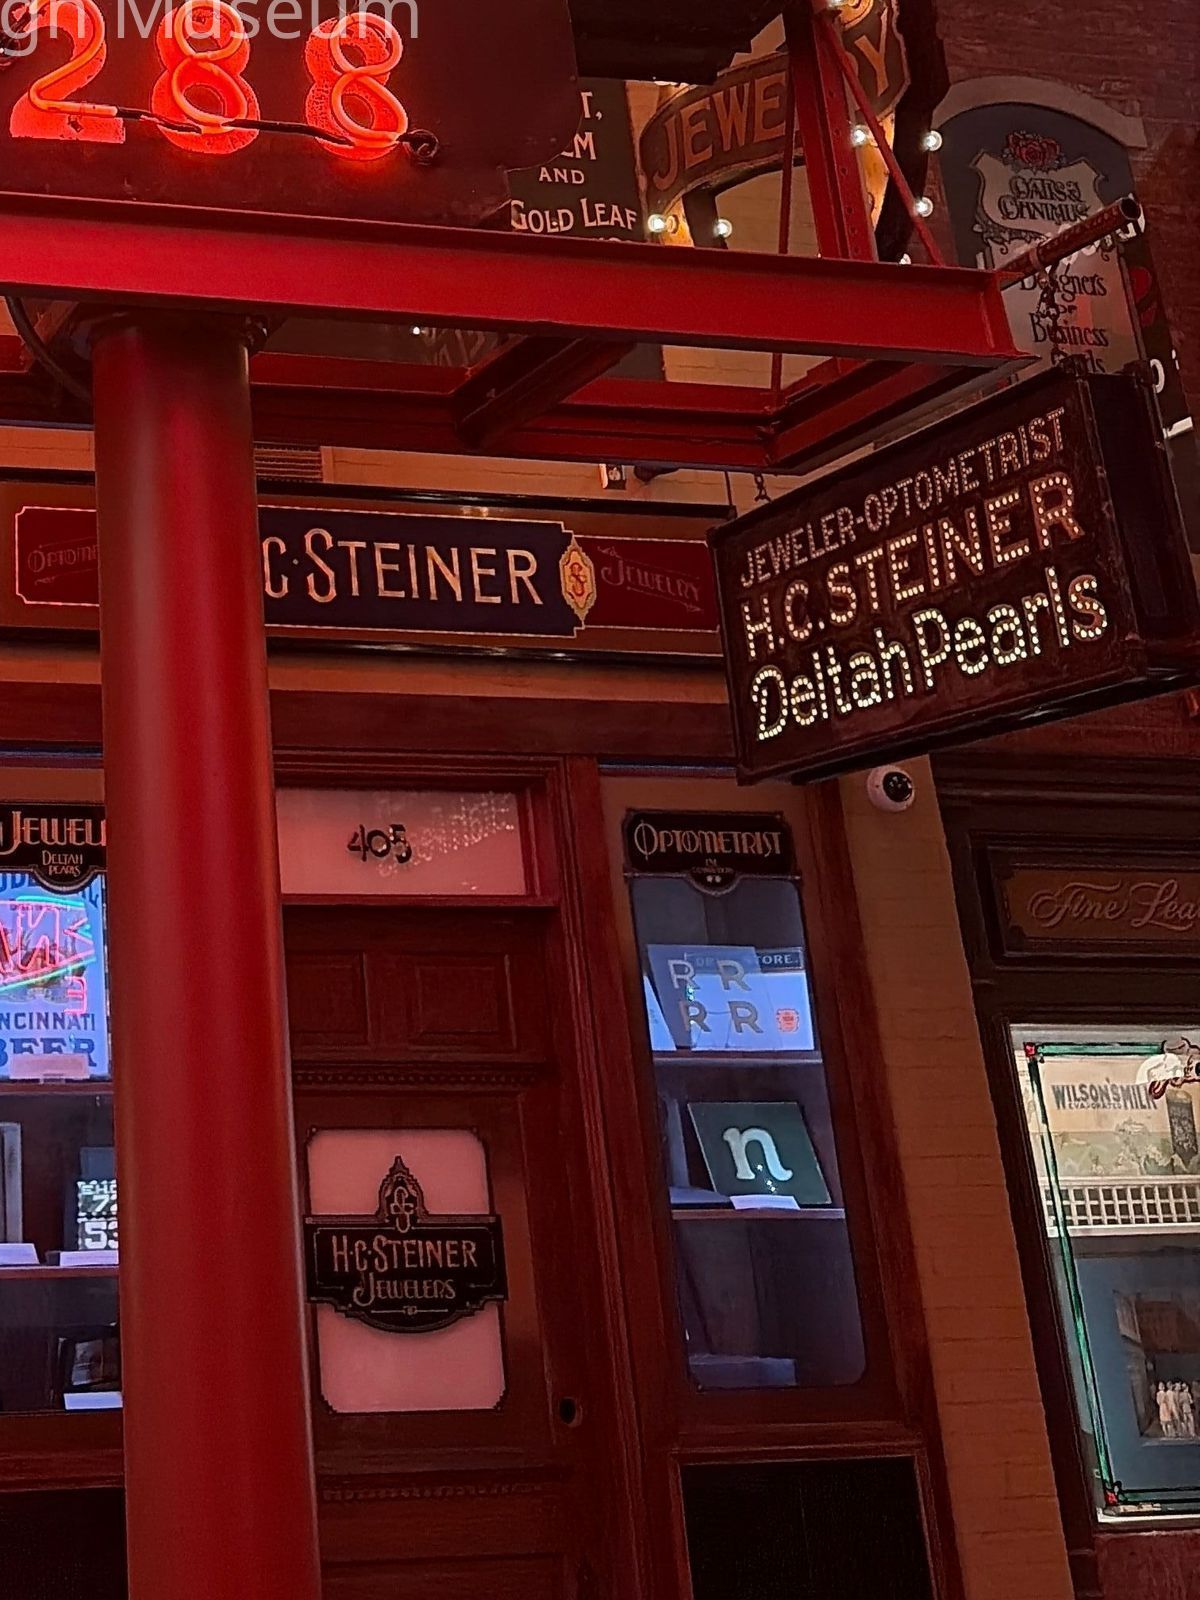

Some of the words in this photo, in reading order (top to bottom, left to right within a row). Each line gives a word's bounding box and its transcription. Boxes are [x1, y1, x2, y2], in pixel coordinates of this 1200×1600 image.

[538, 166, 585, 185] AND
[510, 199, 575, 233] GOLD
[580, 197, 637, 231] LEAF
[304, 526, 545, 605] STEINER
[751, 627, 914, 741] Deltah
[912, 566, 1108, 691] Pearls
[347, 824, 413, 864] 405
[634, 819, 782, 860] OPTOMETRIST
[1027, 879, 1128, 928] Fine
[1130, 879, 1200, 931] Lea
[1119, 1084, 1158, 1110] MILK
[373, 1235, 479, 1273] STEINER
[353, 1271, 457, 1307] JEWELERS
